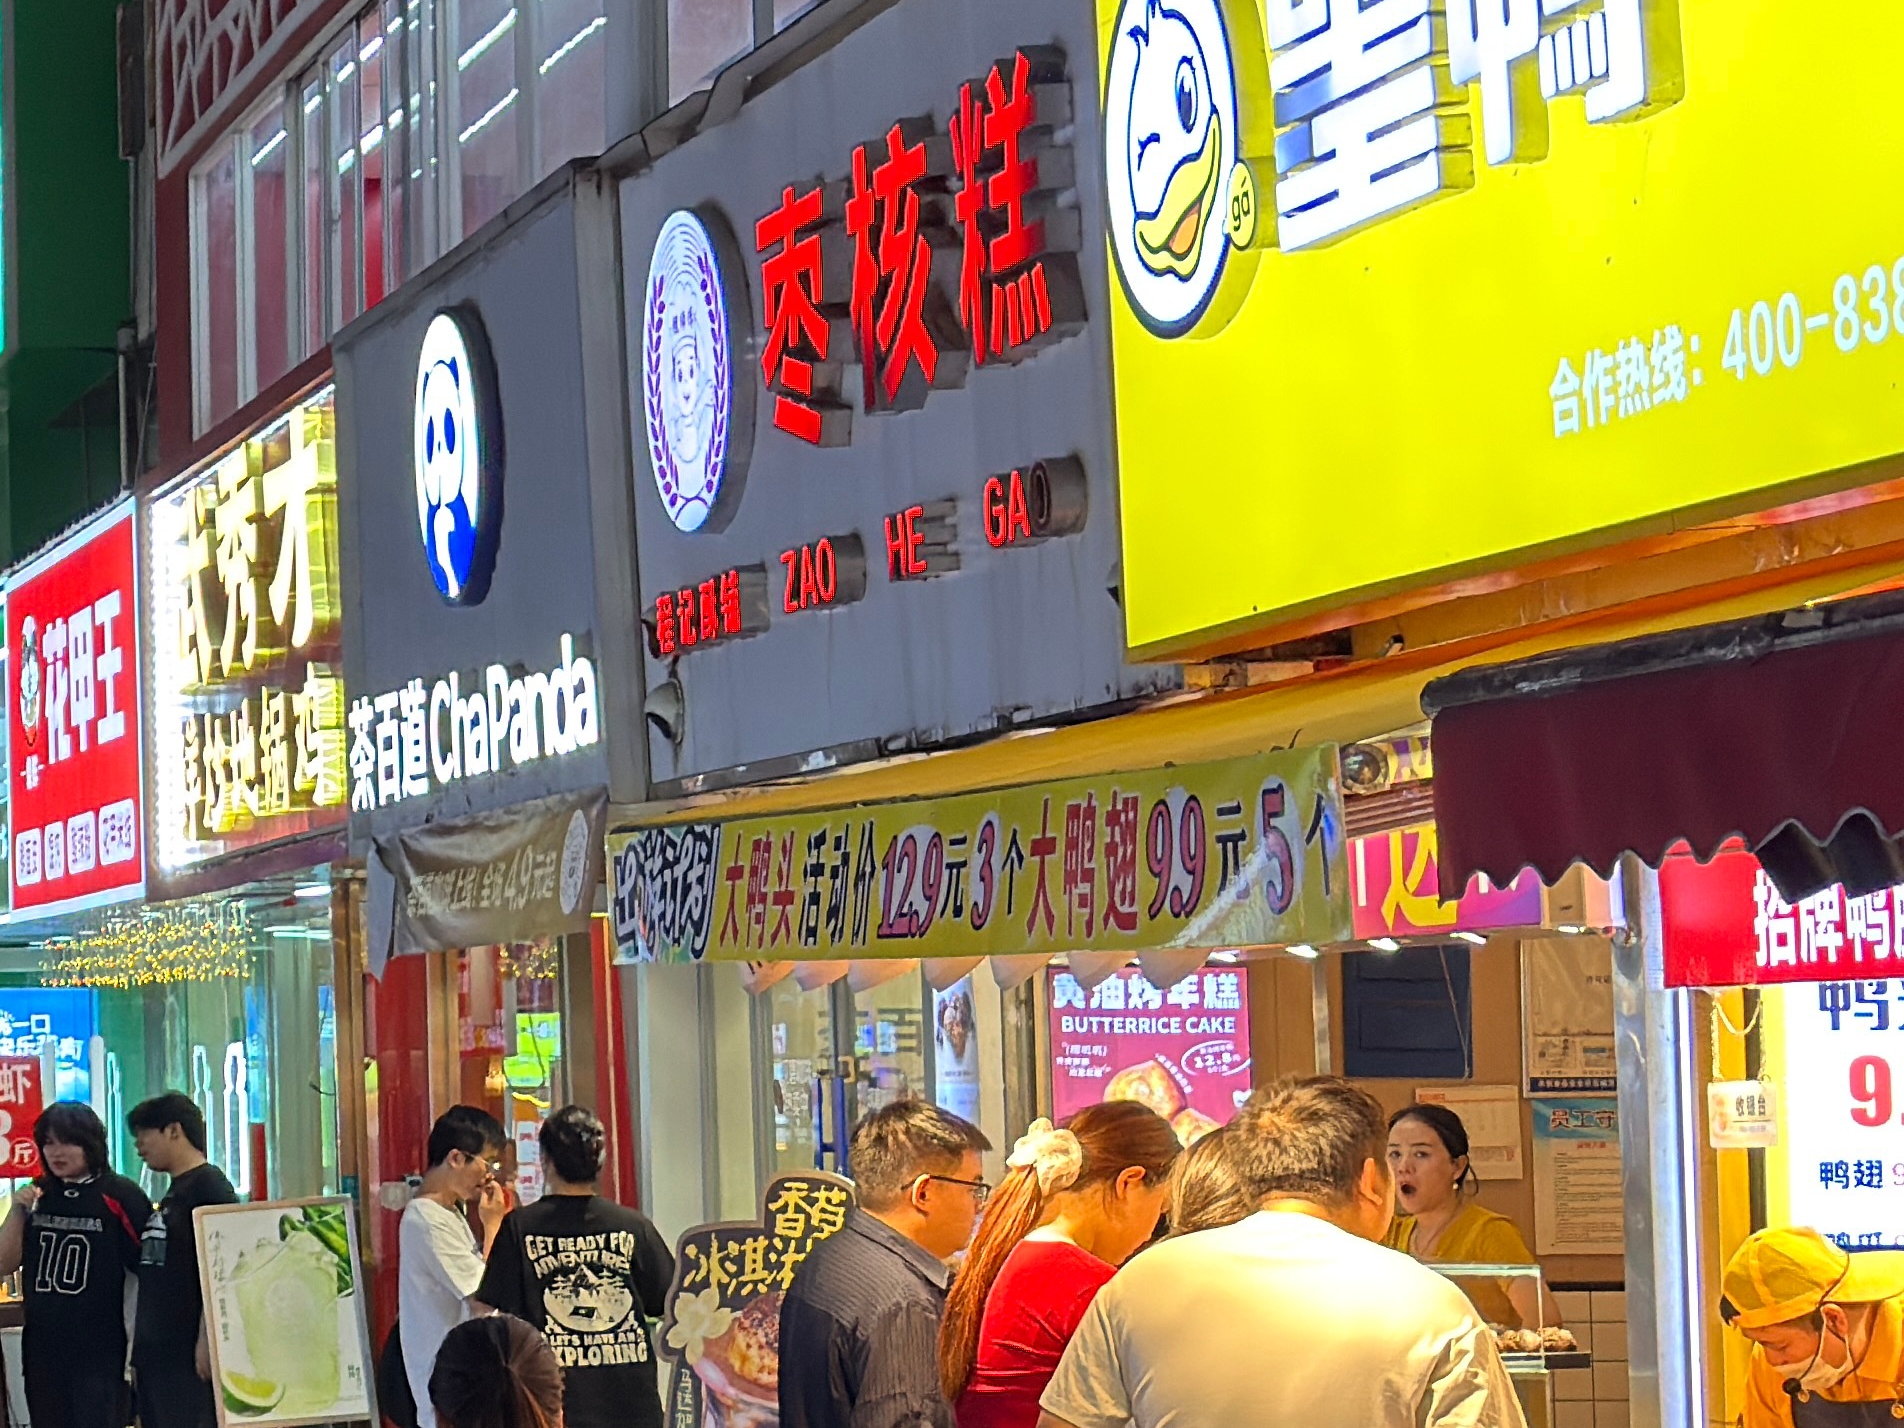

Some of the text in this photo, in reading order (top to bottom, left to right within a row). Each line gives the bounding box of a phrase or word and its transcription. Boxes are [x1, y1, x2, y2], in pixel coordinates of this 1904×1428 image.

[756, 50, 1053, 445] 枣核糕
[780, 536, 837, 613] ZAO
[884, 505, 928, 581] HE
[42, 588, 125, 765] 花甲王
[348, 633, 600, 812] 茶百道 ChaPanda
[1185, 1015, 1237, 1035] CAKE
[1734, 1094, 1768, 1118] 收银台
[1818, 1159, 1886, 1190] 鸭翅
[35, 1230, 91, 1295] 10
[524, 1234, 554, 1261] GET
[557, 1233, 607, 1252] READY
[550, 1341, 648, 1368] XPLORING
